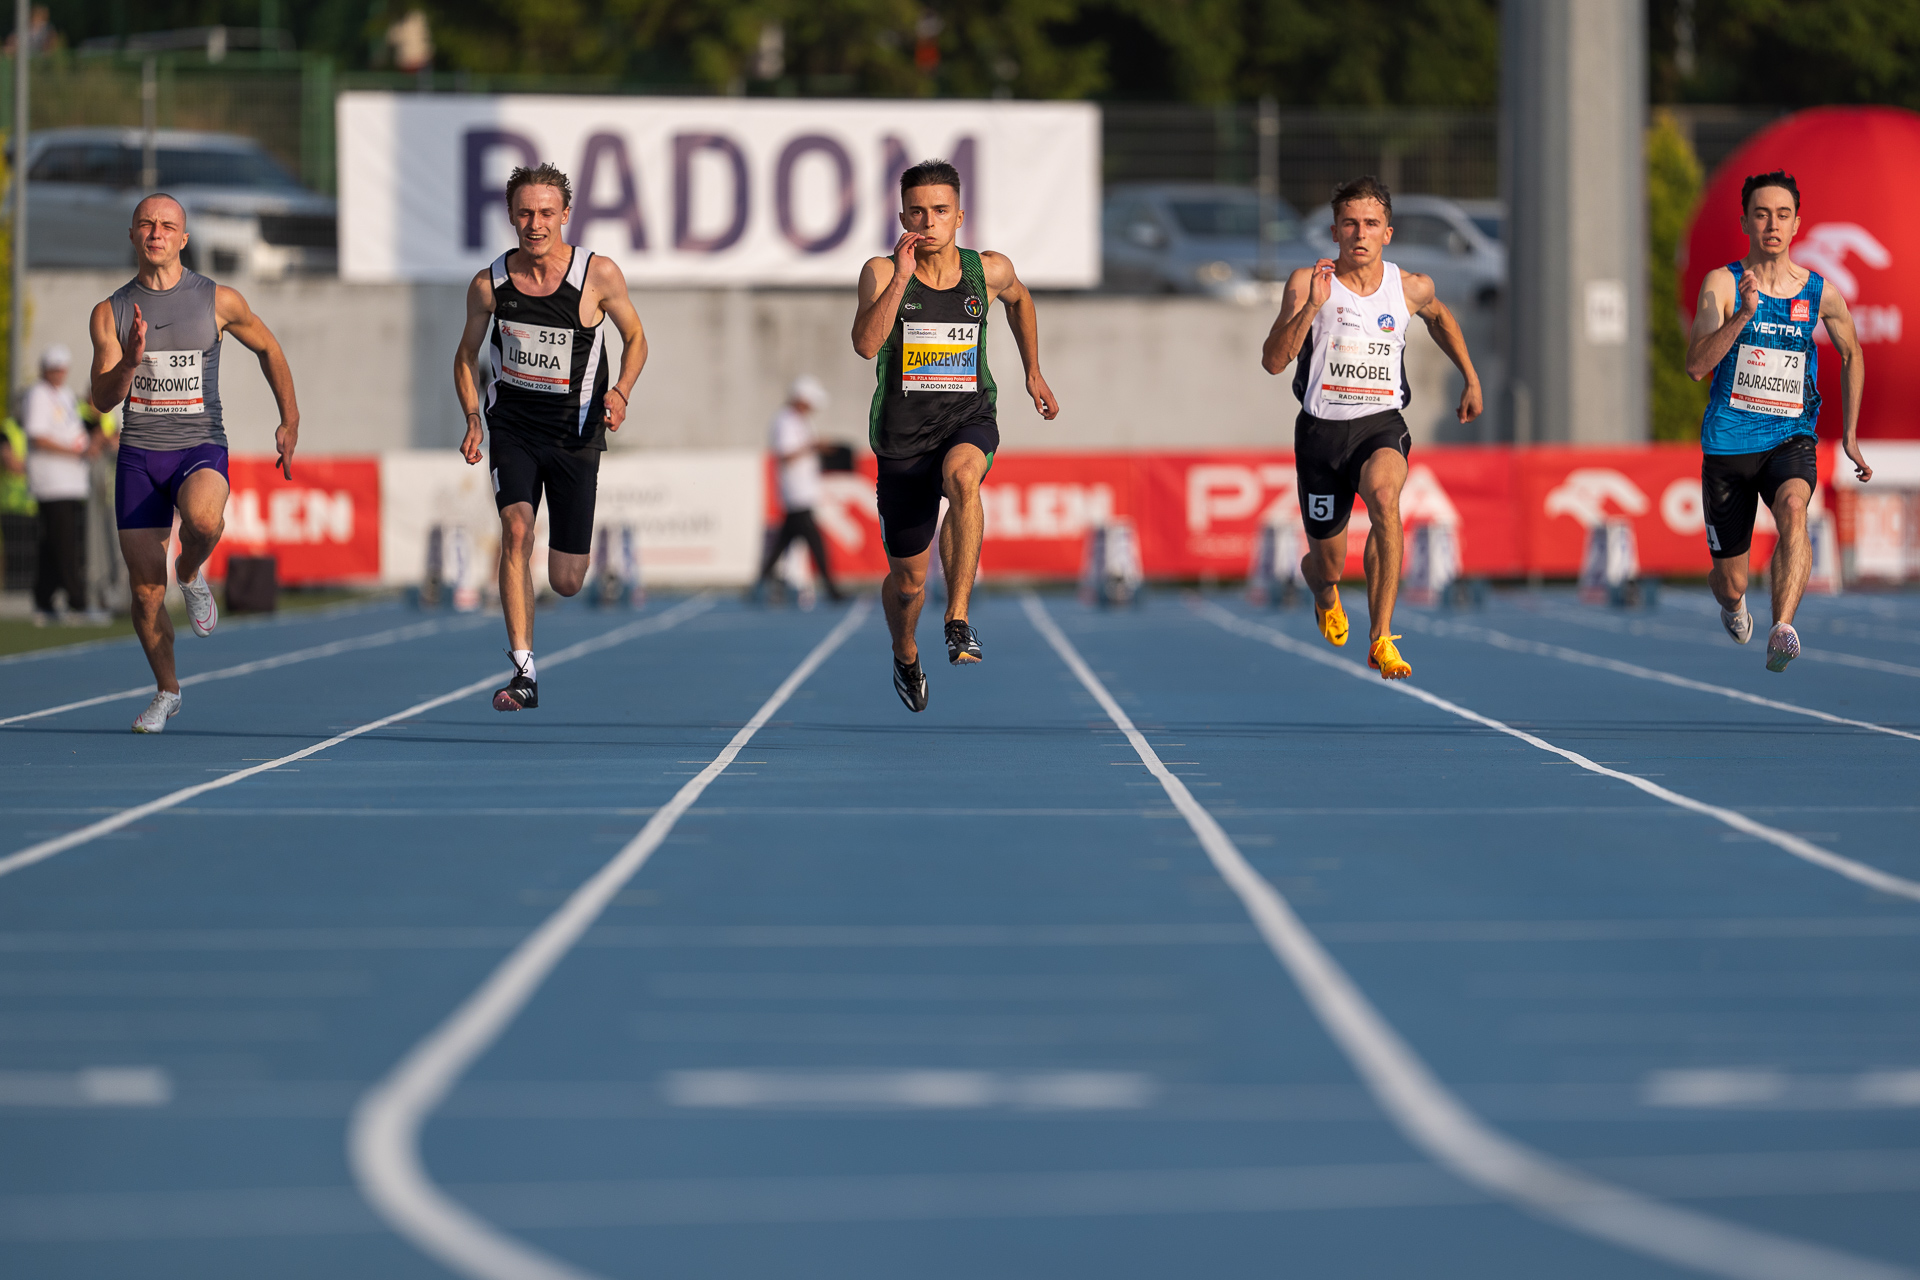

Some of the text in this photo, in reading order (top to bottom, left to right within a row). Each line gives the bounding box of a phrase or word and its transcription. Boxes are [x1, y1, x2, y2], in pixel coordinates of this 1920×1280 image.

[463, 128, 979, 254] RADOM
[947, 328, 973, 340] 414
[1753, 322, 1802, 337] VECTRA
[538, 330, 566, 345] 513
[1368, 343, 1390, 356] 575
[170, 355, 195, 367] 331
[509, 347, 560, 370] LIBURA
[907, 352, 974, 367] ZAKRZEWSKI
[1784, 355, 1798, 368] 73
[1330, 362, 1391, 381] WRÓBEL
[134, 375, 199, 392] GORZKOWICZ
[512, 378, 534, 388] RADOM
[1738, 372, 1801, 394] BAJRASZEWSKI
[1746, 404, 1771, 412] RADOM
[1313, 497, 1328, 518] 5
